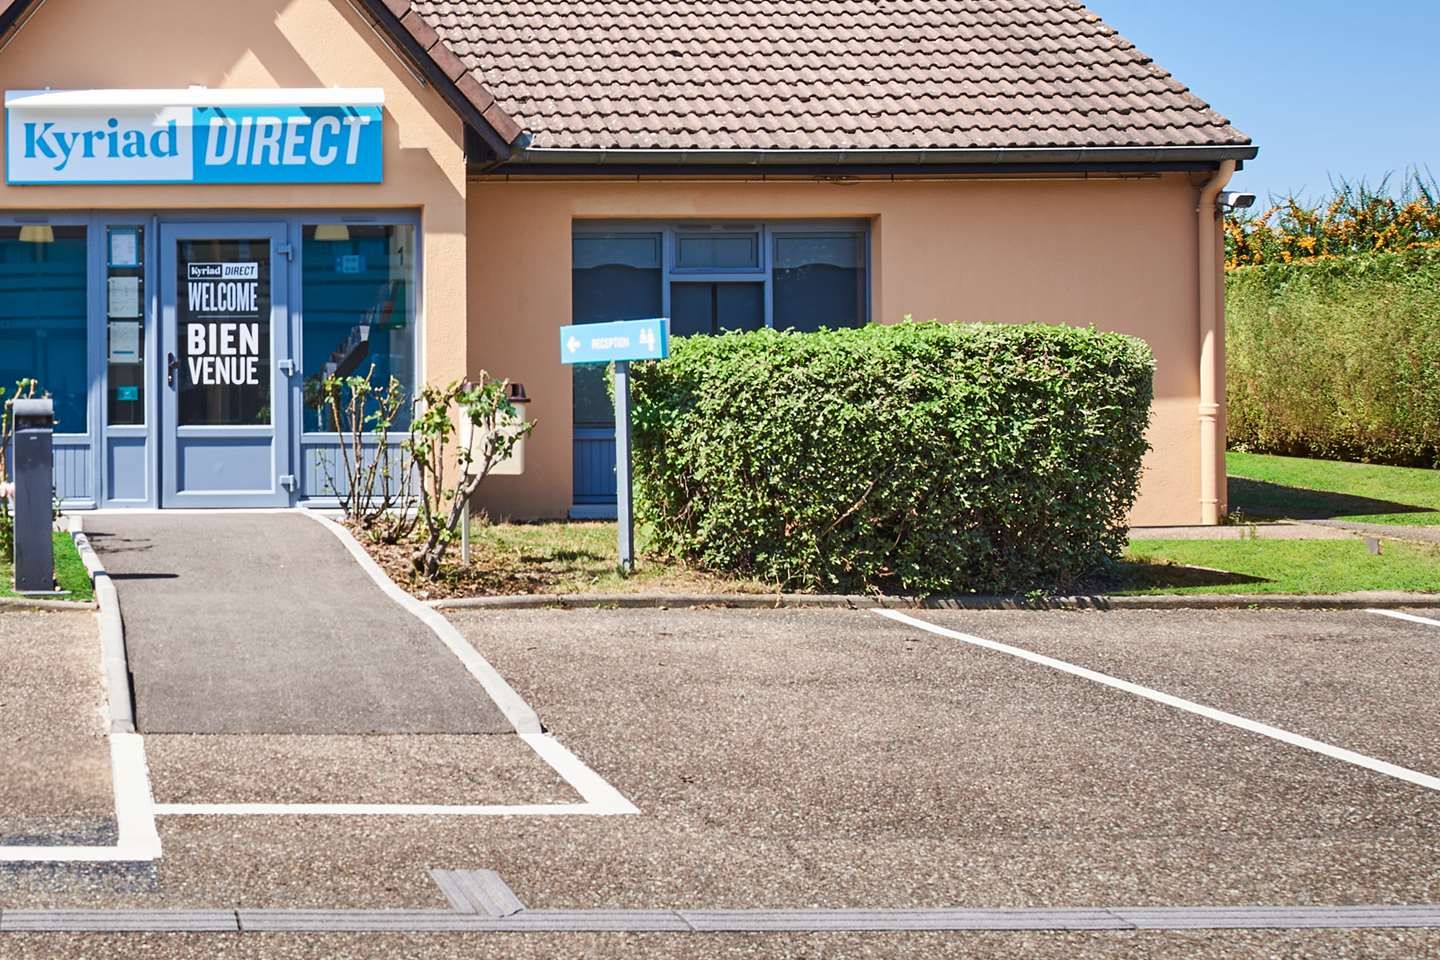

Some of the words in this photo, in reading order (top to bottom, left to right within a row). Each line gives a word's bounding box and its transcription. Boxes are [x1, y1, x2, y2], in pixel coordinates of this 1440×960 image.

[23, 118, 180, 171] Kyriad
[204, 115, 371, 167] DIRECT
[190, 265, 221, 276] Kyriad
[225, 265, 255, 276] DIRECT
[188, 282, 259, 311] WELCOME
[187, 323, 259, 355] BIEN
[187, 357, 259, 385] VENUE
